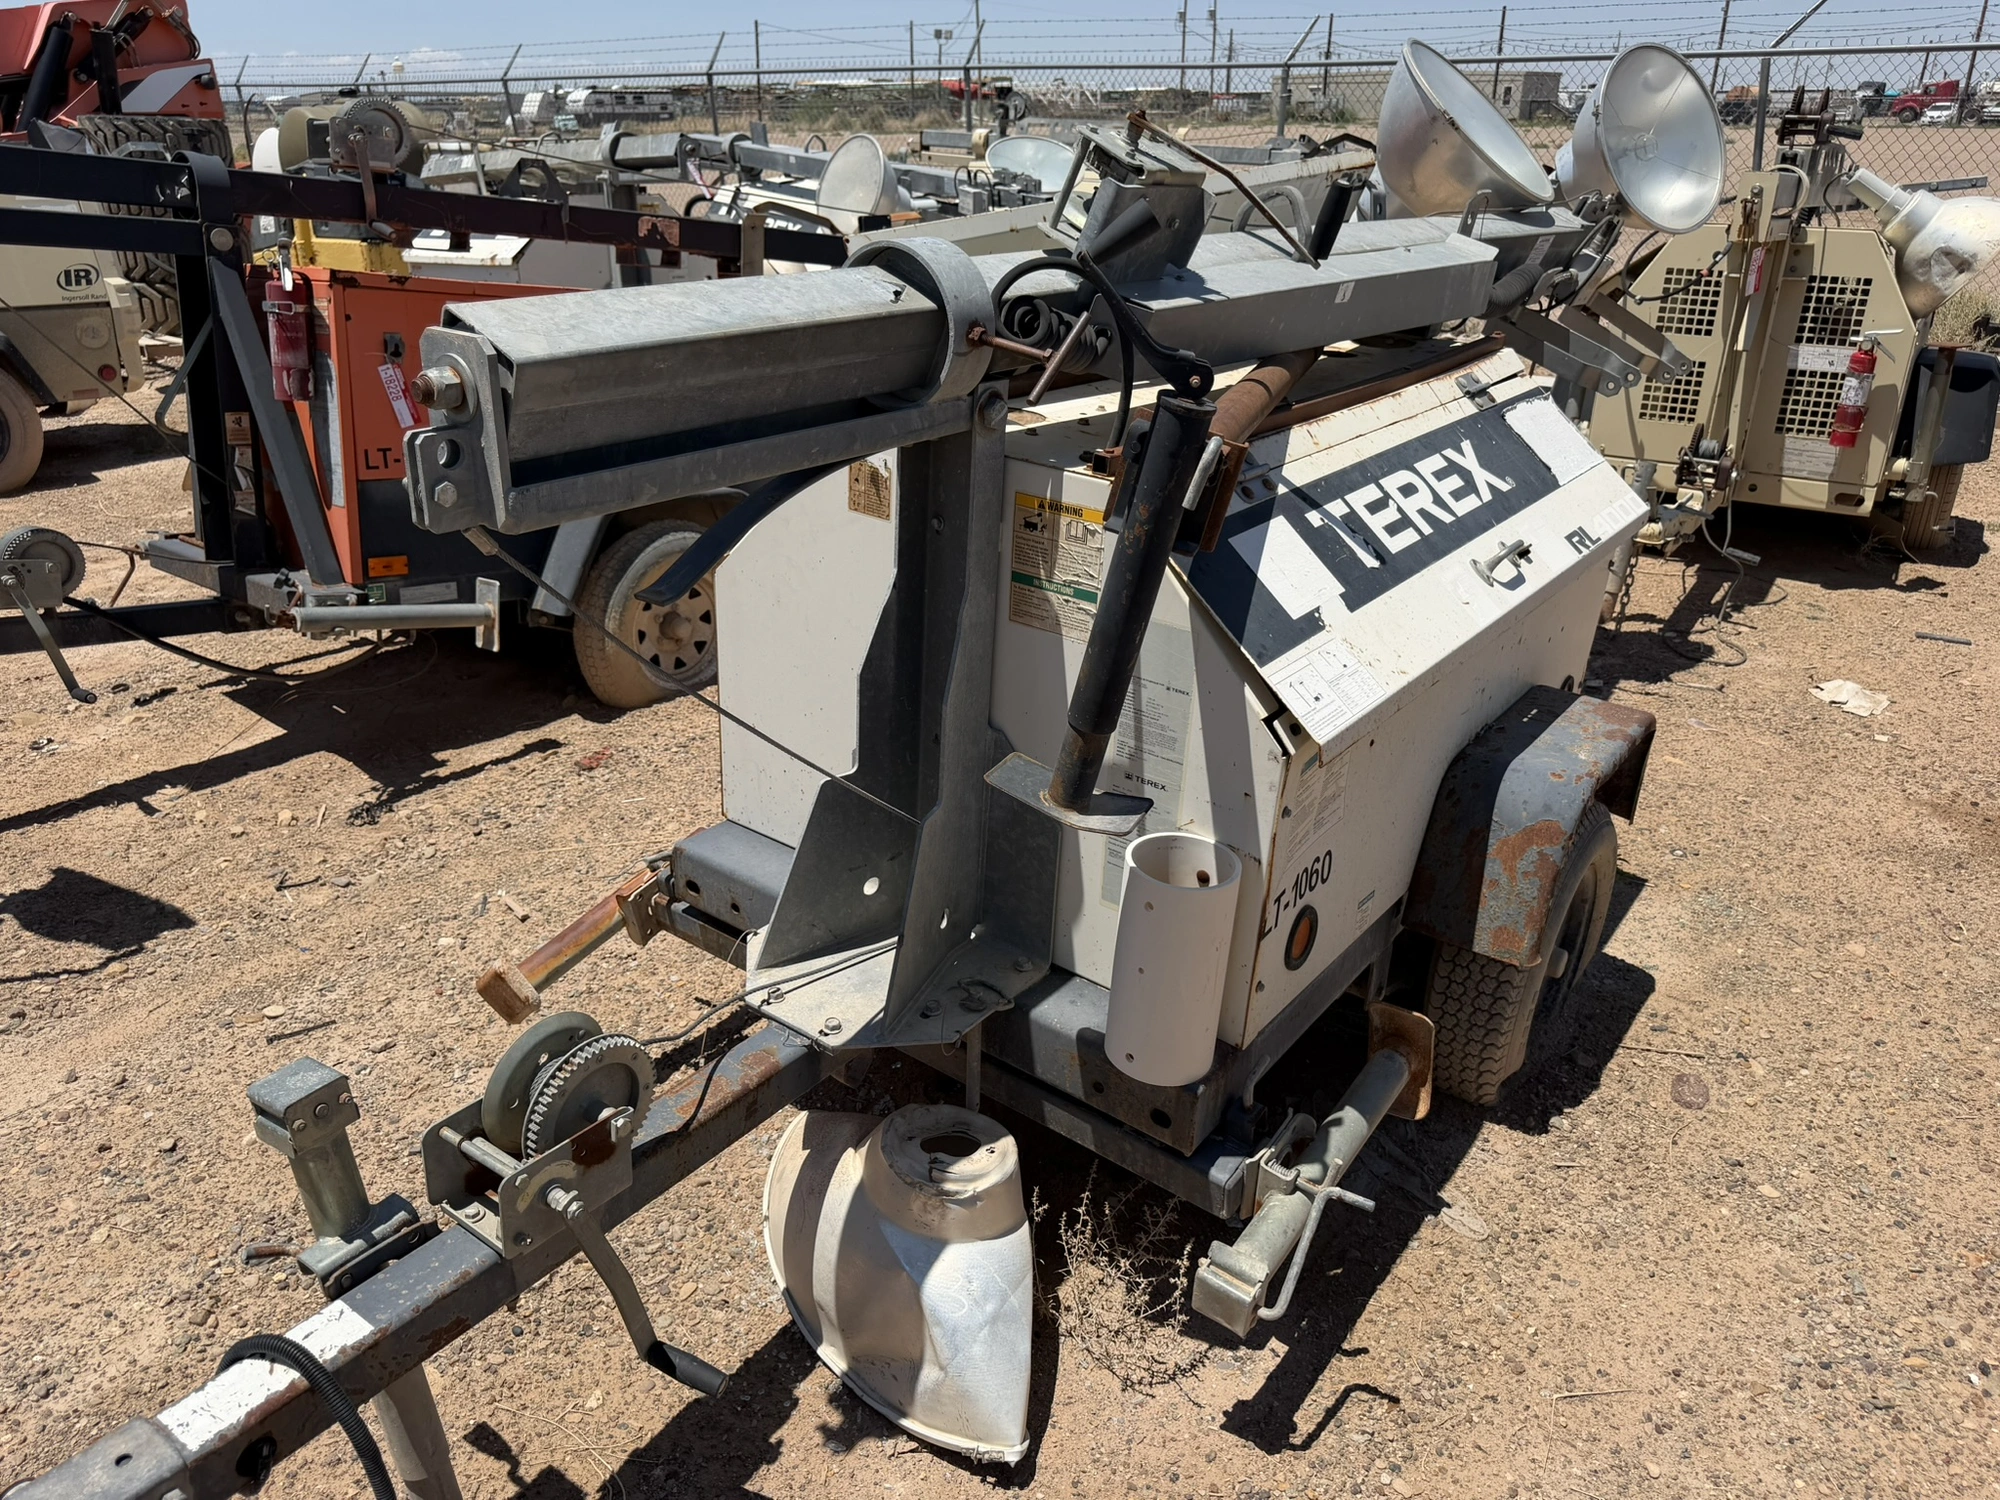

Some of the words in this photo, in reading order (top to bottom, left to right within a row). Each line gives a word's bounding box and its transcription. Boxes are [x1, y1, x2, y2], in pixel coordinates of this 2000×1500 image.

[63, 268, 93, 287] IR
[61, 293, 90, 303] Ingersoll
[90, 292, 108, 301] Rand
[380, 366, 403, 402] 1-18228
[1047, 501, 1084, 518] WARNING
[1305, 439, 1511, 570] TEREX
[1033, 578, 1075, 596] INSTRUCTIONS
[1134, 774, 1167, 792] TEREX
[1259, 849, 1333, 942] LT-1060
